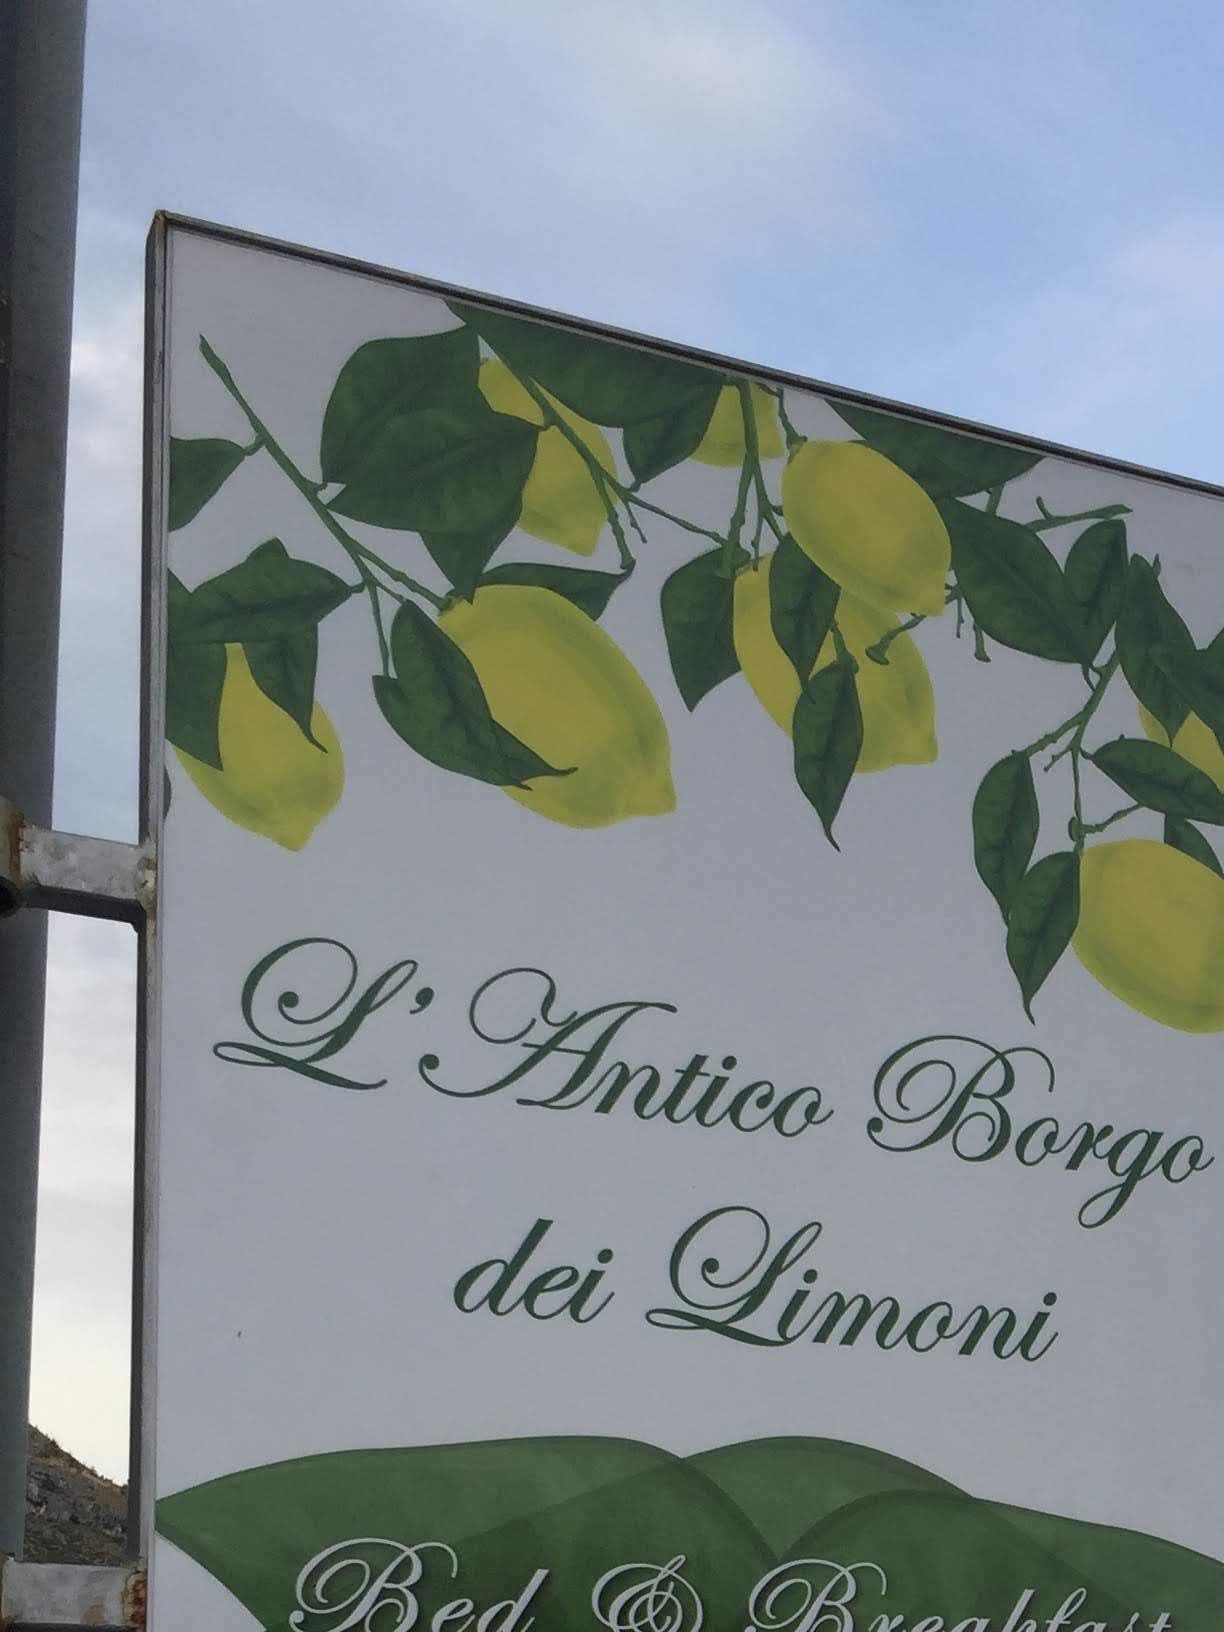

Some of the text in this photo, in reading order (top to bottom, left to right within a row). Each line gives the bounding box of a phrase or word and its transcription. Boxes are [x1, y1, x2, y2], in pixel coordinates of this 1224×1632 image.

[212, 937, 1220, 1229] L'Antico Borgo
[453, 1206, 1059, 1362] dei Limoni
